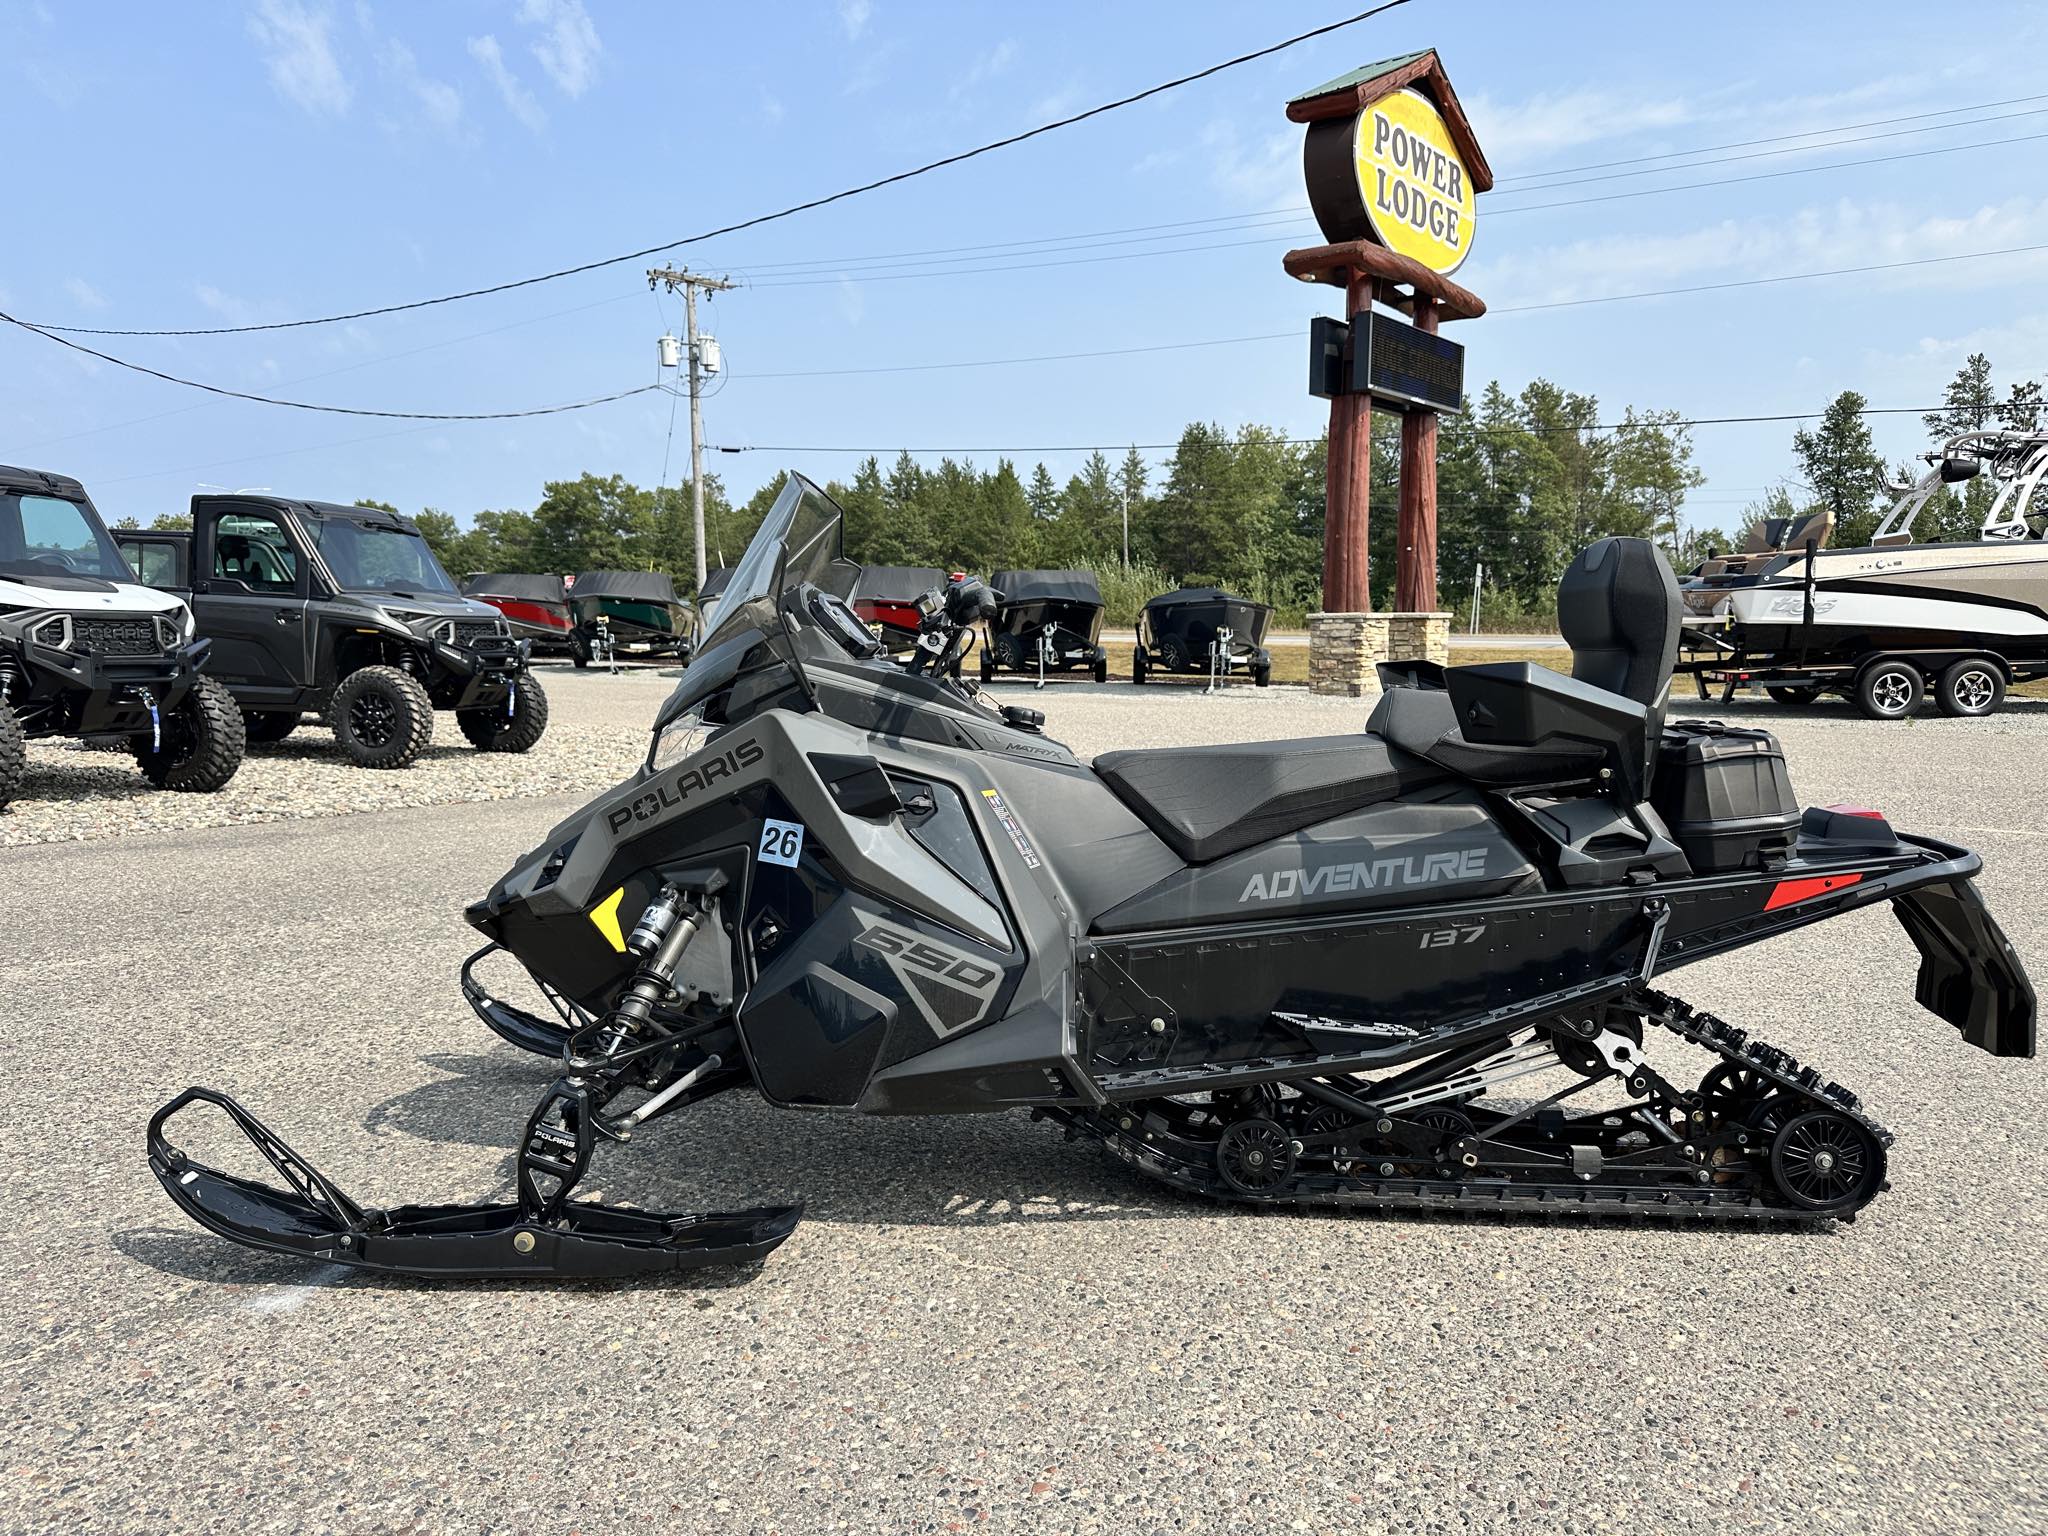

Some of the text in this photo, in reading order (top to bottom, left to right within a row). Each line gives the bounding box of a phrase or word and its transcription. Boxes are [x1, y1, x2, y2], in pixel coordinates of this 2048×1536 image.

[1374, 113, 1463, 203] POWER
[1376, 168, 1459, 248] LODGE
[75, 626, 152, 639] POLARIS
[1005, 742, 1063, 760] MATRYX
[607, 736, 765, 835] POLARIS
[761, 826, 799, 859] 26
[1238, 847, 1488, 904] ADVENTURE
[855, 926, 996, 990] 650
[1419, 925, 1486, 950] 137
[534, 1129, 576, 1149] POLARIS
